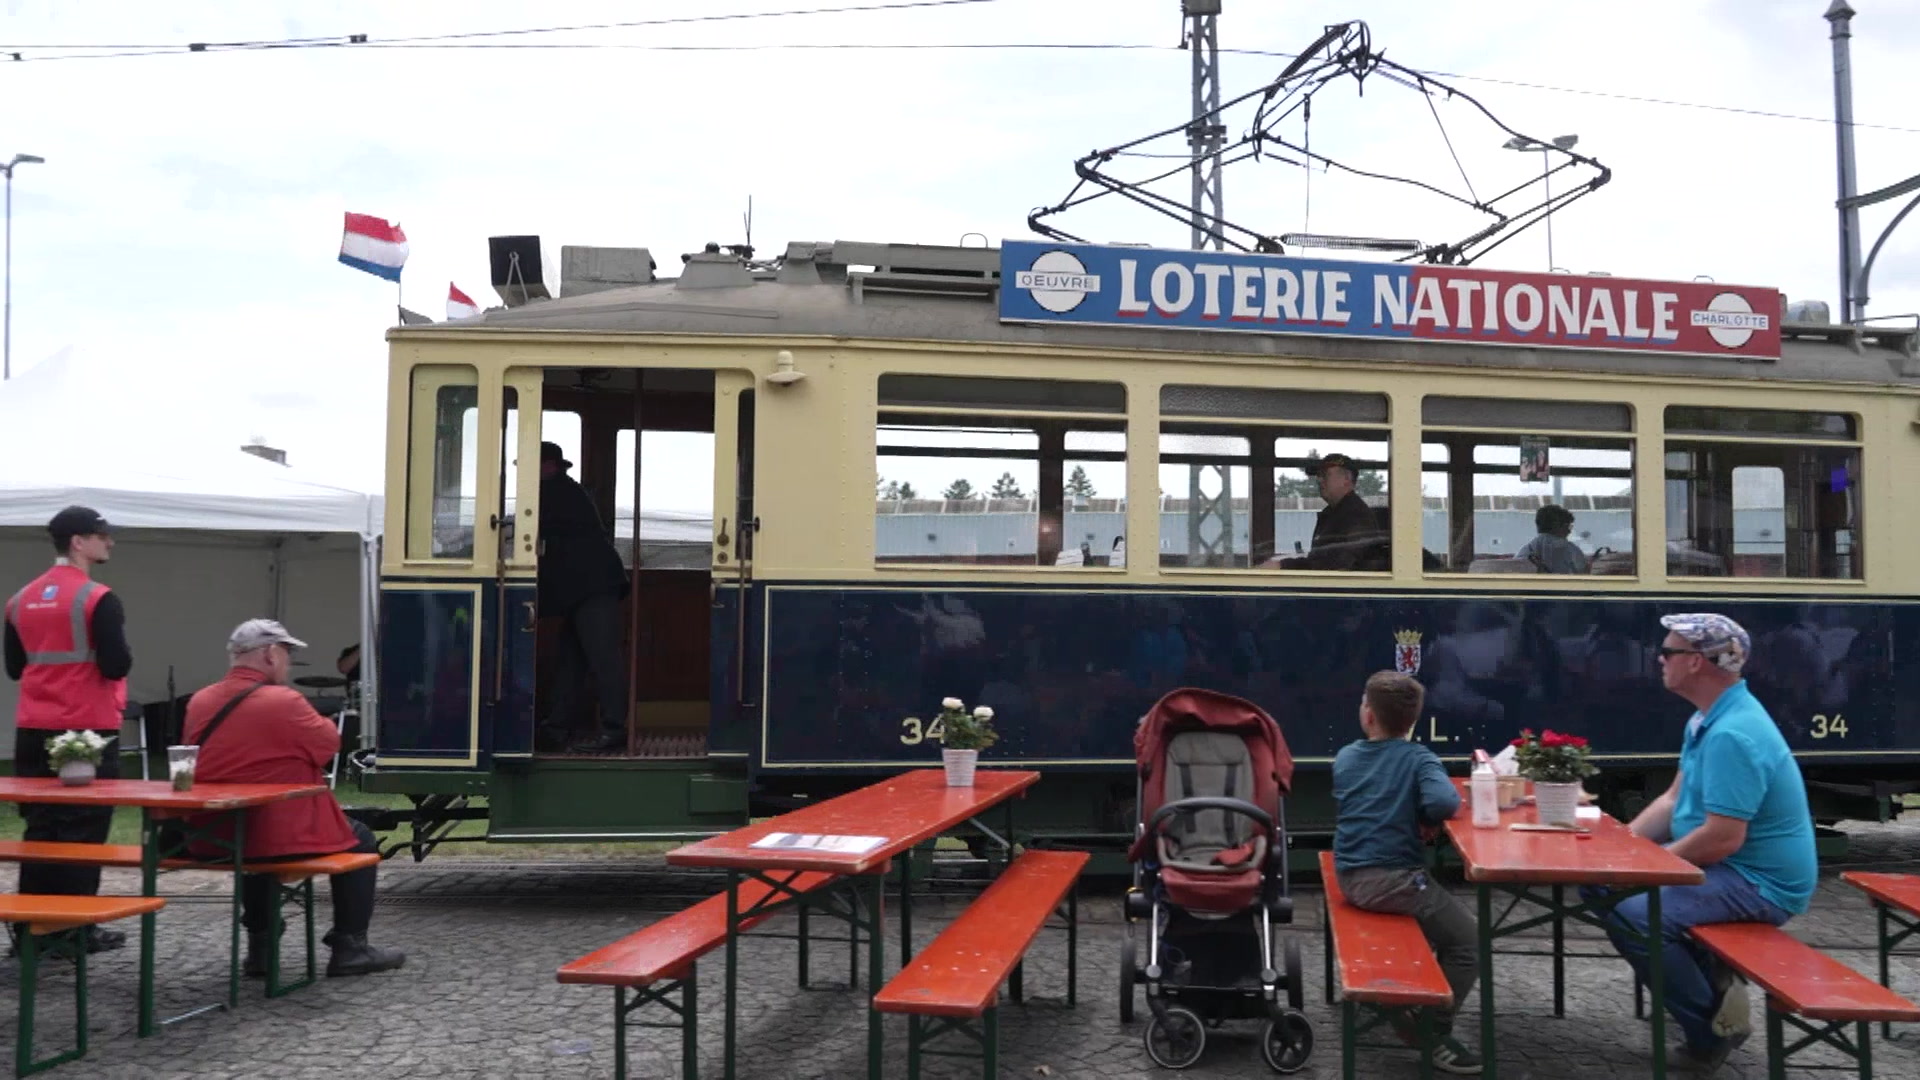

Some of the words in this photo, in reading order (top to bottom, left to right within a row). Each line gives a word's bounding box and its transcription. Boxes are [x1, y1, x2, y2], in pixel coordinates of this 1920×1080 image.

[1118, 259, 1352, 326] LOTERIE
[1372, 274, 1680, 343] NATIONALE
[1693, 312, 1767, 328] CHARLOTTE
[1810, 713, 1849, 739] 34
